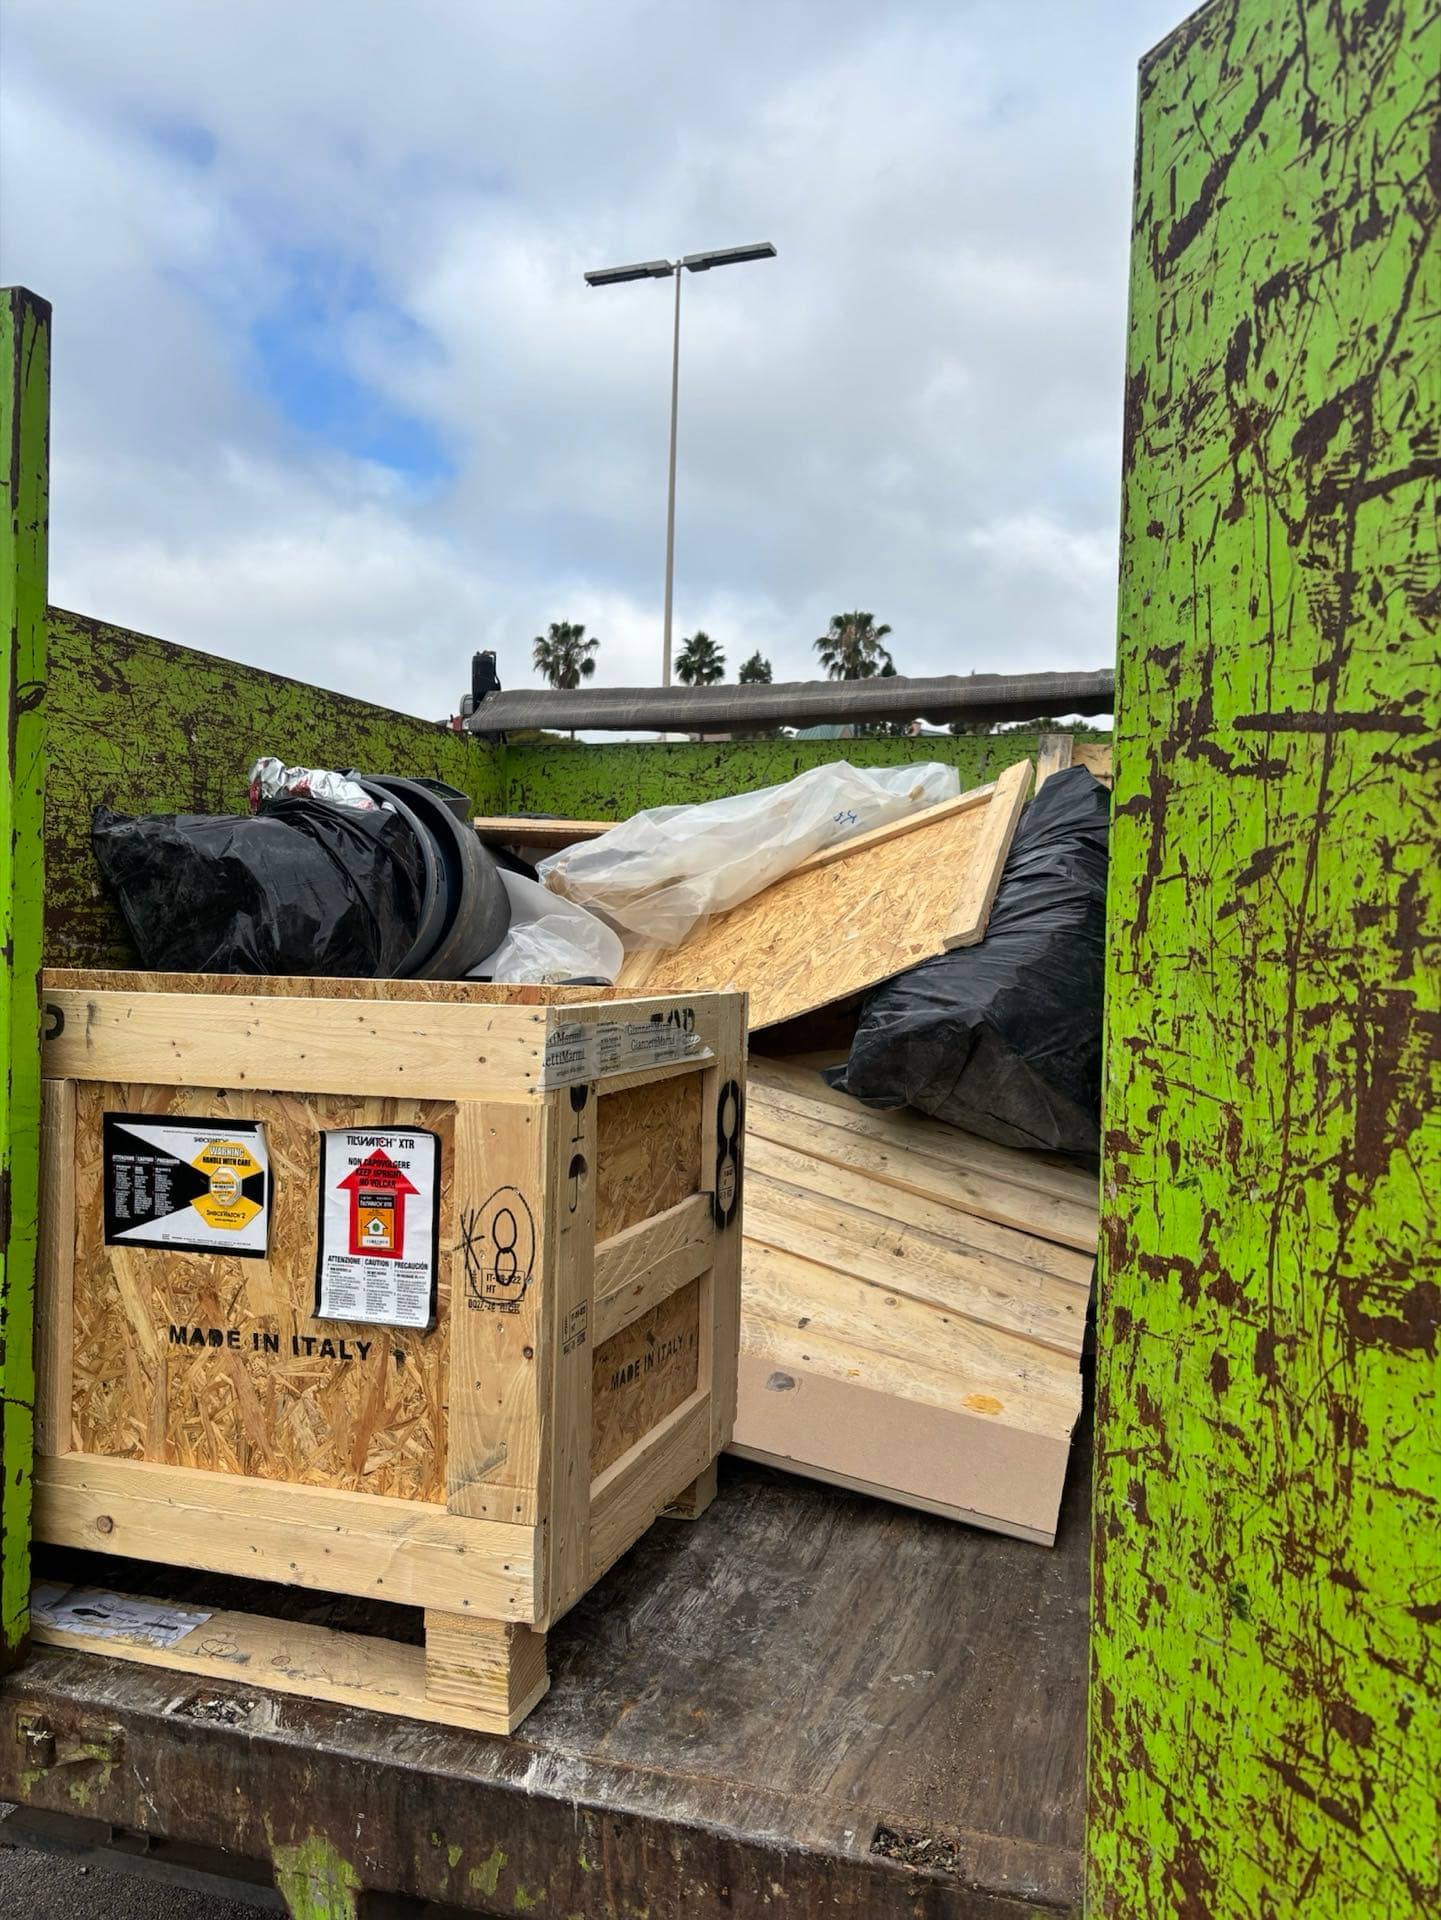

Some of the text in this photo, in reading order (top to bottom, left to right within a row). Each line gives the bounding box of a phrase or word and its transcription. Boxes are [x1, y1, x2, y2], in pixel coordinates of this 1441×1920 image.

[399, 1139, 415, 1149] XTR
[237, 1158, 251, 1166] CARE
[364, 1258, 390, 1267] CAUTION
[486, 1285, 497, 1294] HT
[168, 1324, 372, 1361] MADE IN ITALY
[610, 1359, 640, 1391] MADE
[643, 1350, 655, 1372] IN
